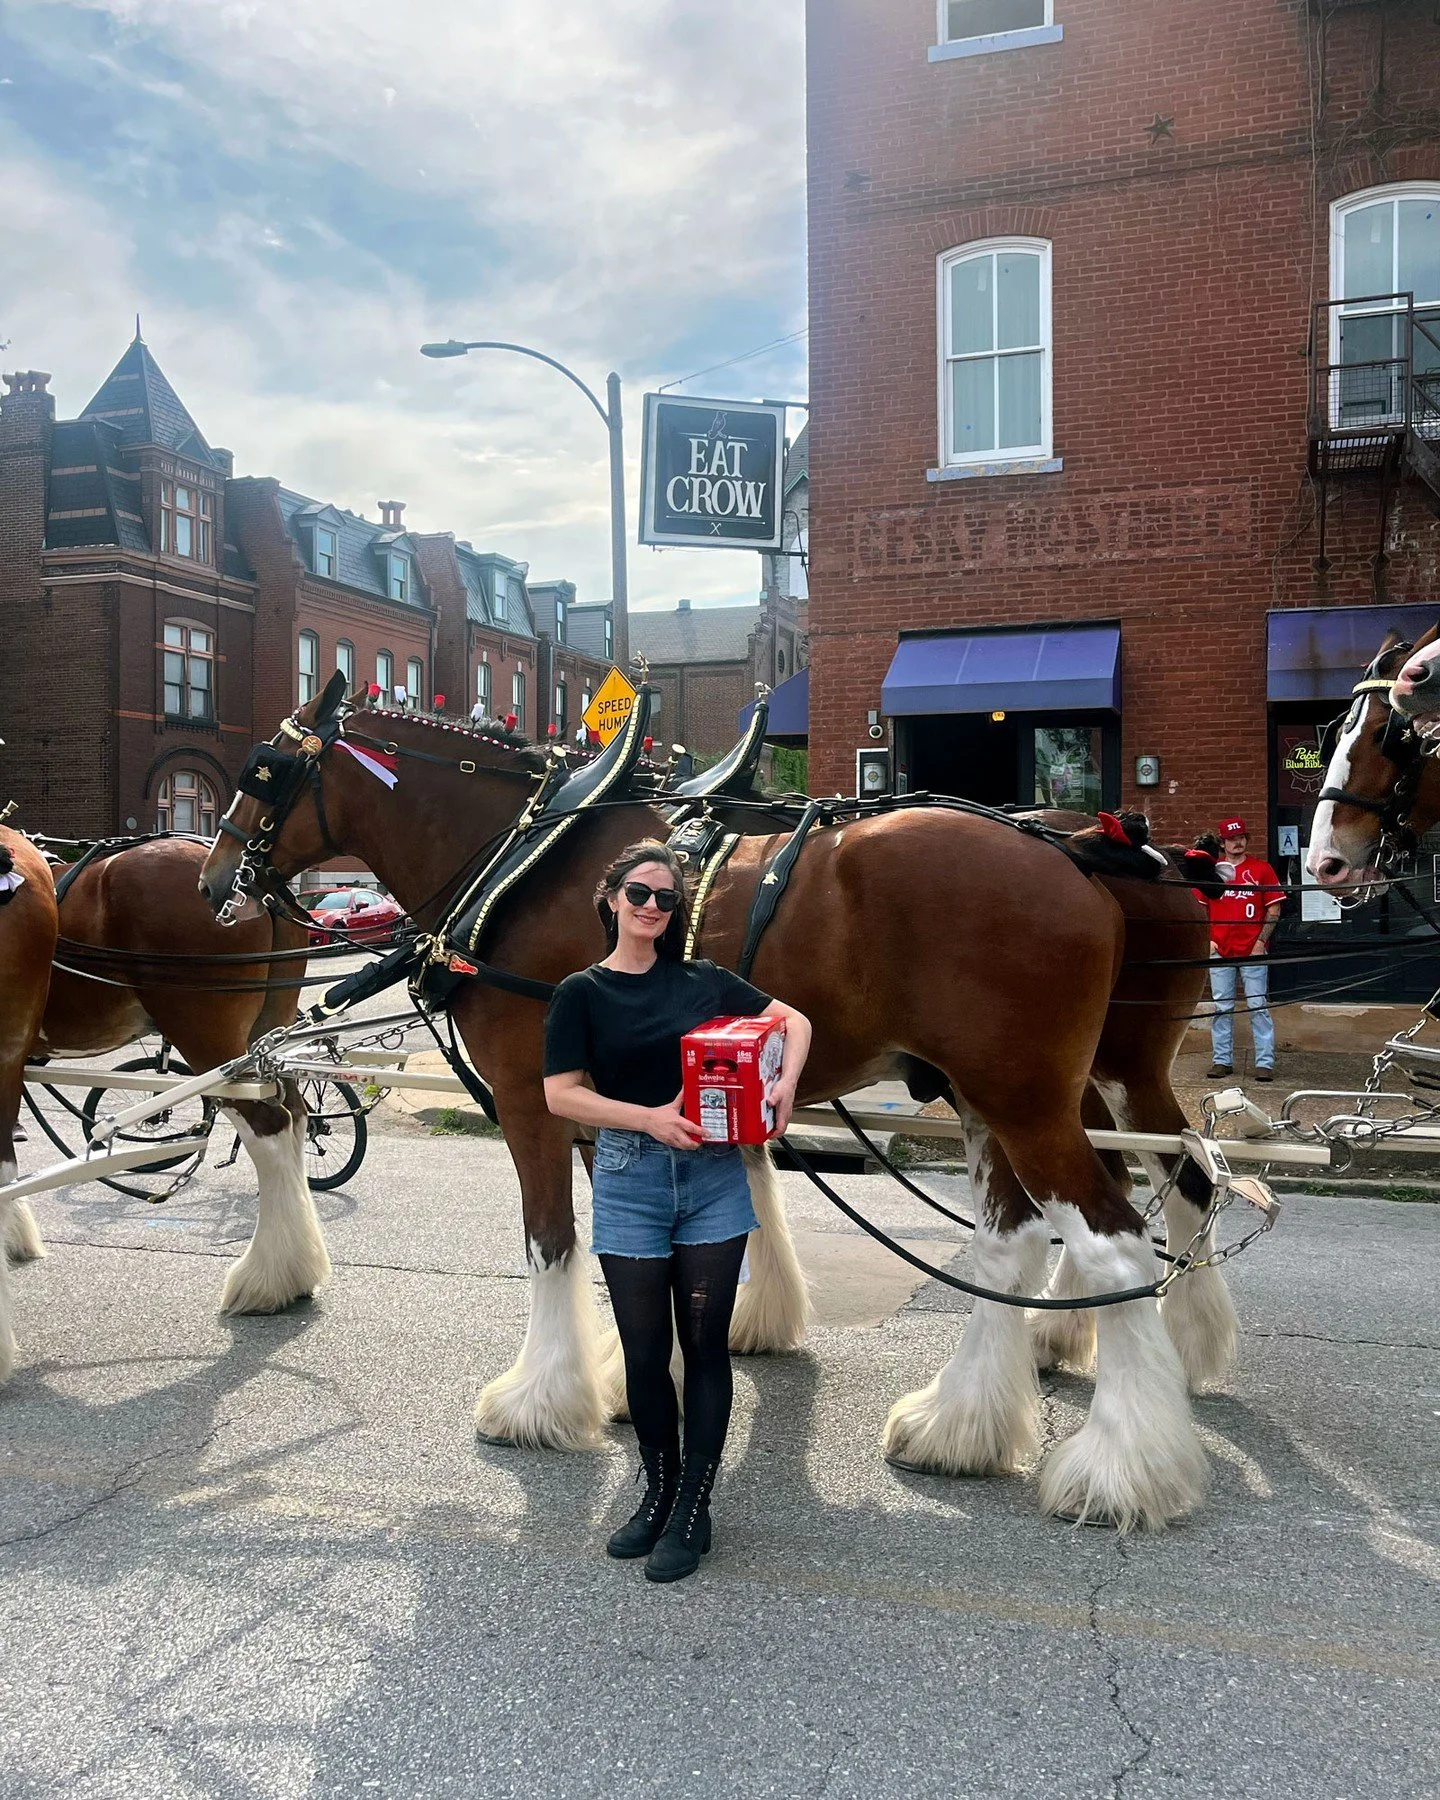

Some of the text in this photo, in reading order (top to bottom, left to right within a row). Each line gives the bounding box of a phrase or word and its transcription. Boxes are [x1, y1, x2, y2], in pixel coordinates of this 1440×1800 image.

[688, 438, 748, 477] EAT
[666, 475, 766, 518] CROW
[597, 697, 631, 714] SPEED
[1294, 747, 1321, 760] Pabst
[1285, 759, 1304, 769] Blue
[1227, 822, 1241, 831] STL
[1283, 835, 1293, 847] A
[1245, 903, 1255, 918] 0
